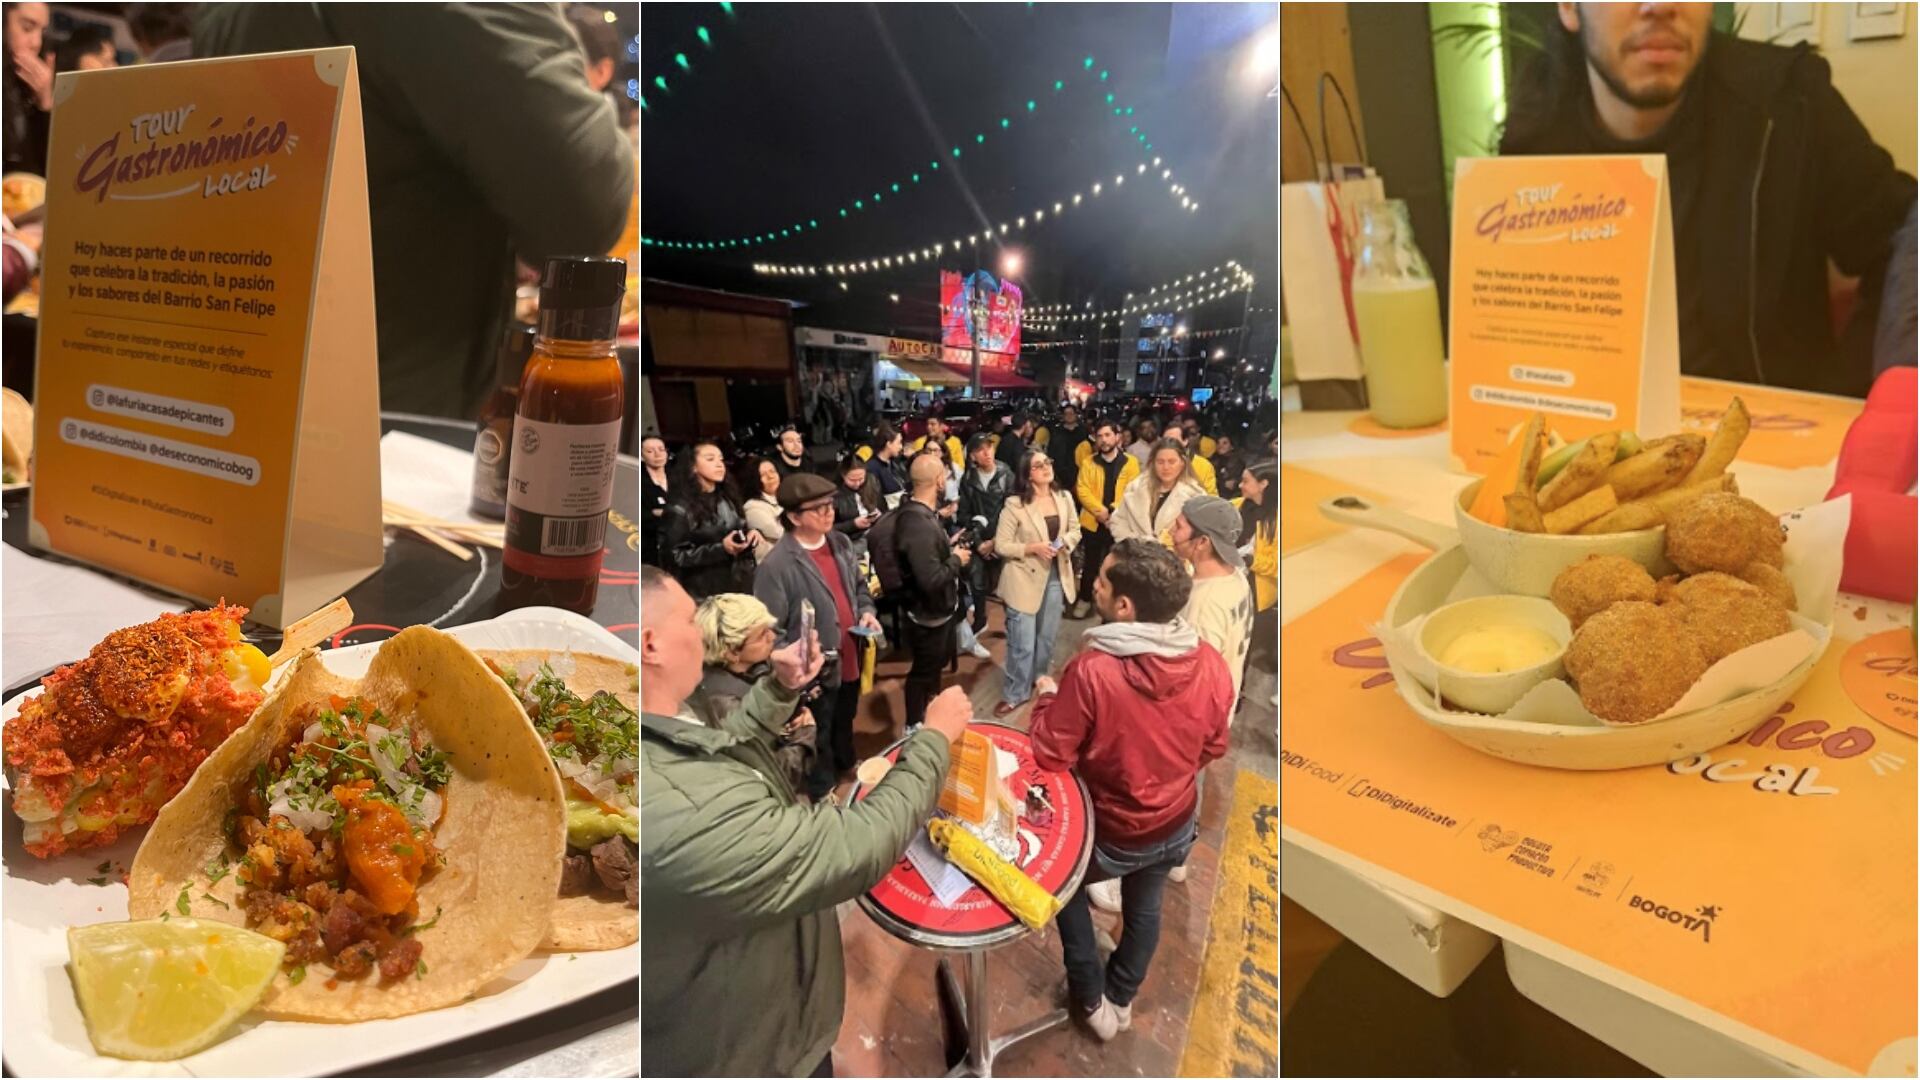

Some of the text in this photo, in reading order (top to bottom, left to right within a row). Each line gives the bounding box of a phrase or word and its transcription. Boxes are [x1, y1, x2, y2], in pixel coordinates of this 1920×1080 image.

[75, 116, 288, 202] Gastronómico
[1475, 193, 1626, 243] Gastronómico
[75, 241, 272, 267] Hoy haces parte de un recorrido
[71, 263, 274, 291] que celebra la tradición, la pasión
[1476, 269, 1620, 286] Hoy haces parte de un recorrido
[68, 283, 275, 318] y los sabores del Barrio San Felipe
[1472, 296, 1623, 316] y los sabores del Barrio San Felipe
[107, 393, 224, 427] @lafuriacasadepicantes
[80, 426, 253, 480] @didicolombia @deseconomicobog
[1302, 762, 1344, 784] Food
